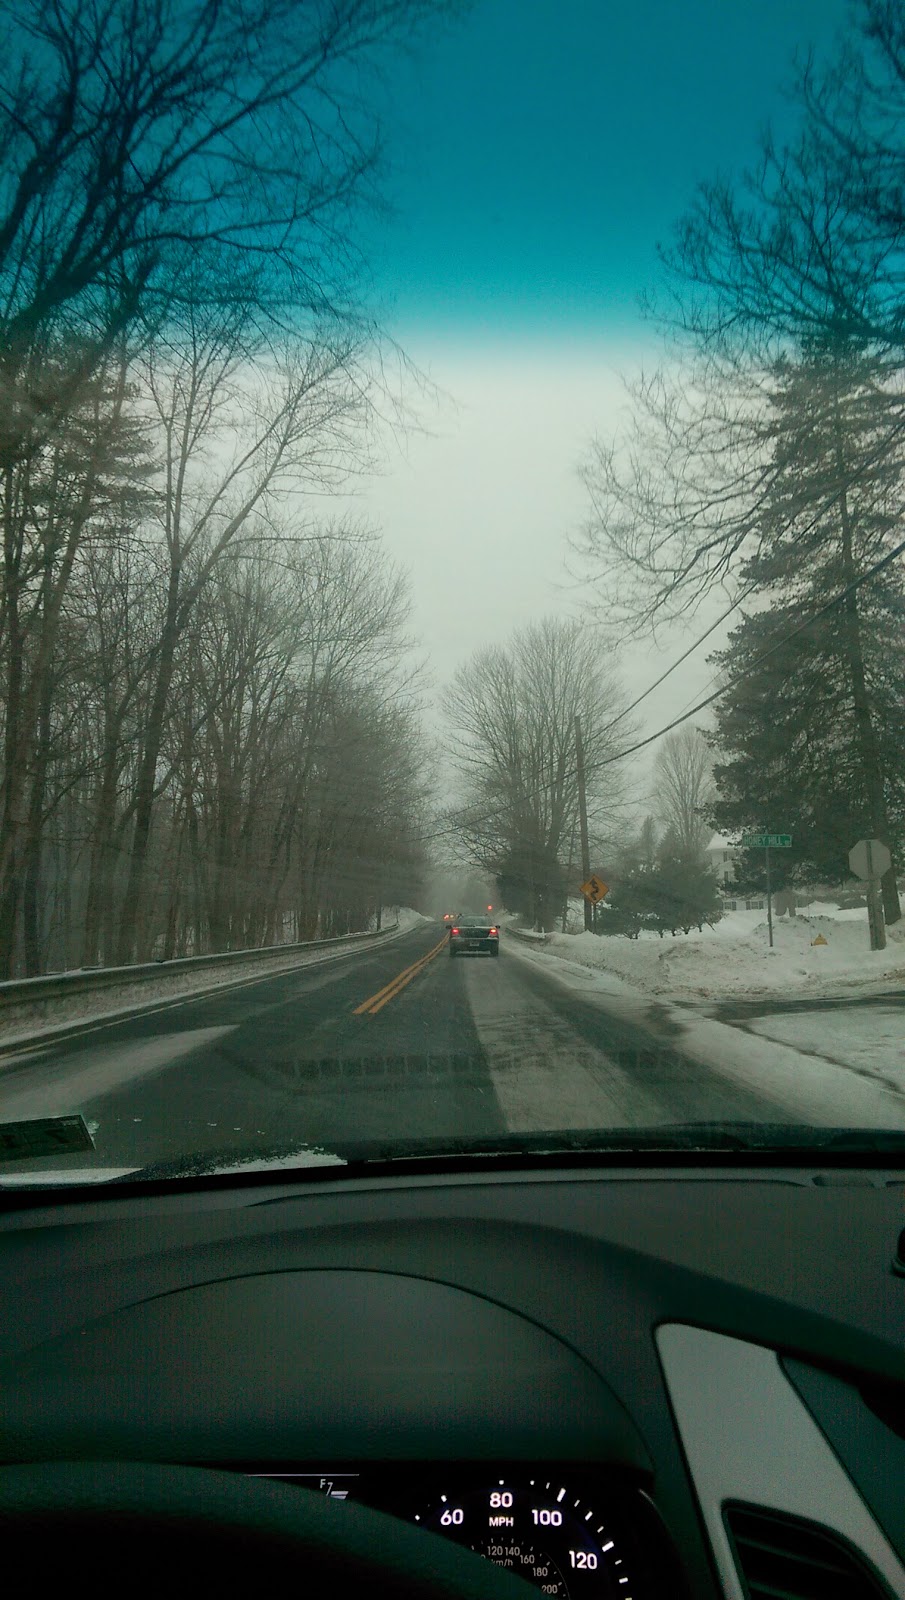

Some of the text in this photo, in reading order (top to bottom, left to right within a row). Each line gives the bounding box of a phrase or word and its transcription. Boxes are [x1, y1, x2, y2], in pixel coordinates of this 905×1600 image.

[744, 836, 766, 846] HONEY
[768, 836, 783, 846] HILL
[320, 1478, 326, 1489] F
[489, 1492, 513, 1508] 80
[440, 1509, 464, 1526] 60
[489, 1516, 514, 1527] MPH
[531, 1509, 563, 1526] 100
[487, 1546, 503, 1556] 120
[504, 1546, 521, 1557] 140
[520, 1554, 535, 1564] 160
[569, 1550, 598, 1570] 120
[532, 1567, 548, 1577] 180
[541, 1584, 558, 1594] 200
